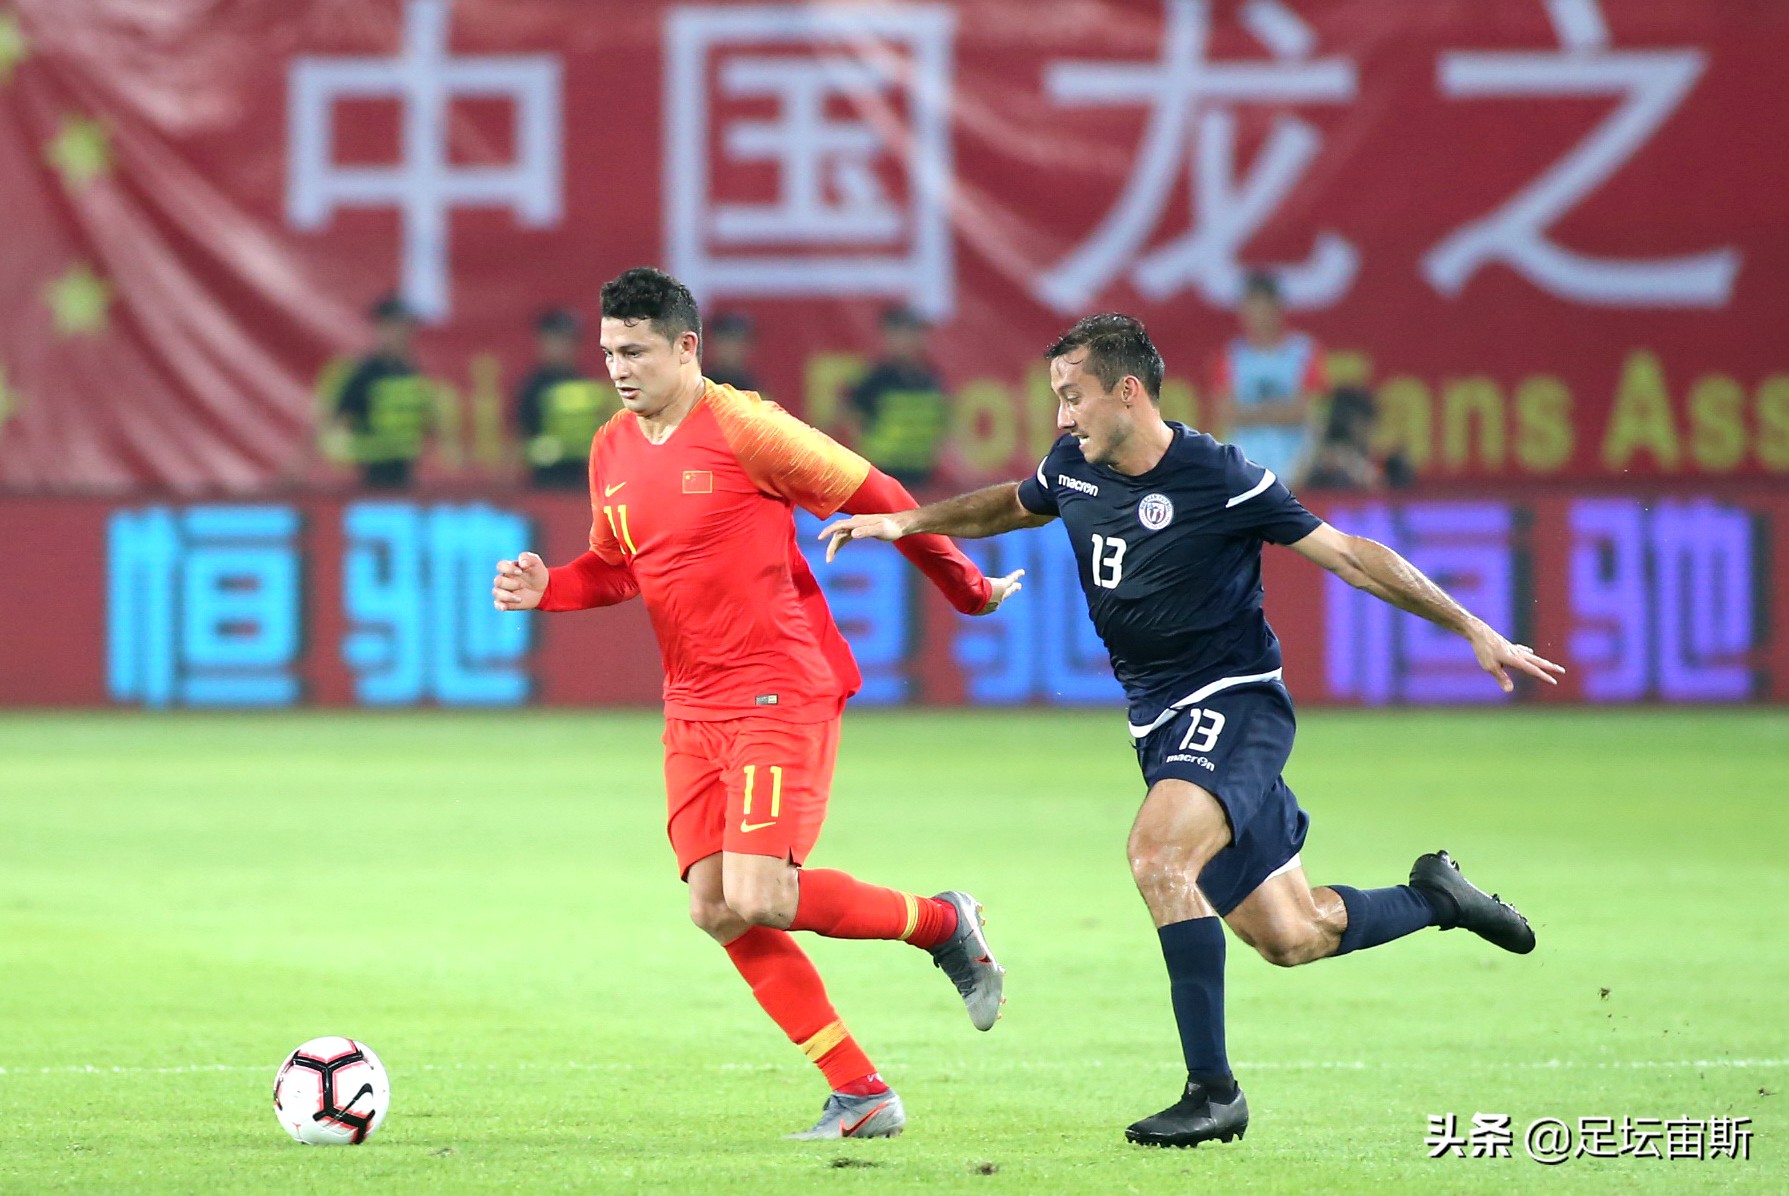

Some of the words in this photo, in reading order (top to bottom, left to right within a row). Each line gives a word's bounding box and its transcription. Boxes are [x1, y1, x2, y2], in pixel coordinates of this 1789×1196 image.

[1058, 474, 1099, 497] macron
[603, 504, 637, 555] 11
[1091, 533, 1127, 589] 13
[107, 503, 531, 708] 恒驰
[1179, 708, 1226, 752] 13
[1166, 753, 1215, 772] macron
[743, 764, 783, 818] 11
